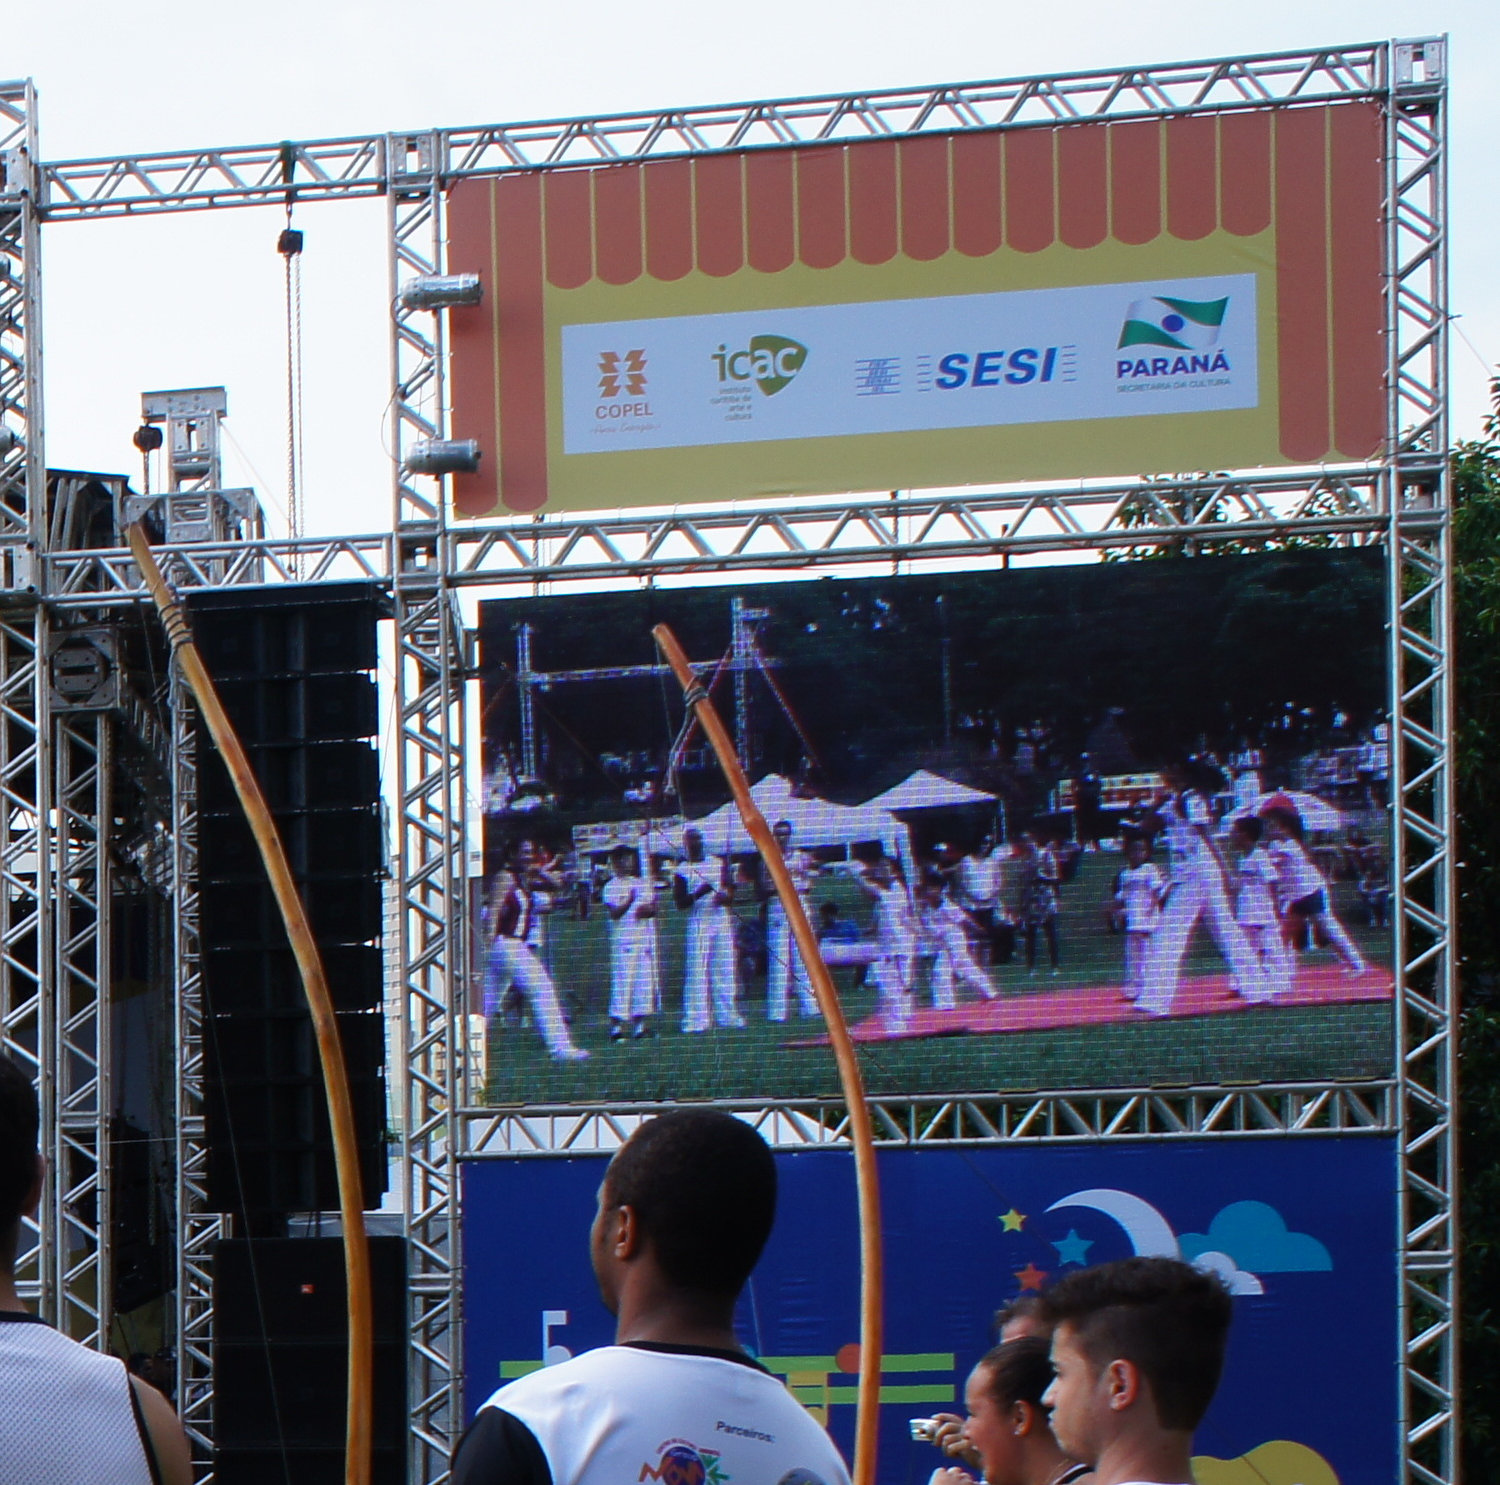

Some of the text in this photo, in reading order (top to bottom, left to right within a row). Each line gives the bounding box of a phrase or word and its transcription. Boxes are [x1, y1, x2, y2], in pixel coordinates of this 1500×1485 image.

[711, 343, 798, 382] icac
[935, 347, 1059, 390] SESI
[1117, 349, 1230, 379] PARANÁ
[595, 402, 654, 420] COPEL
